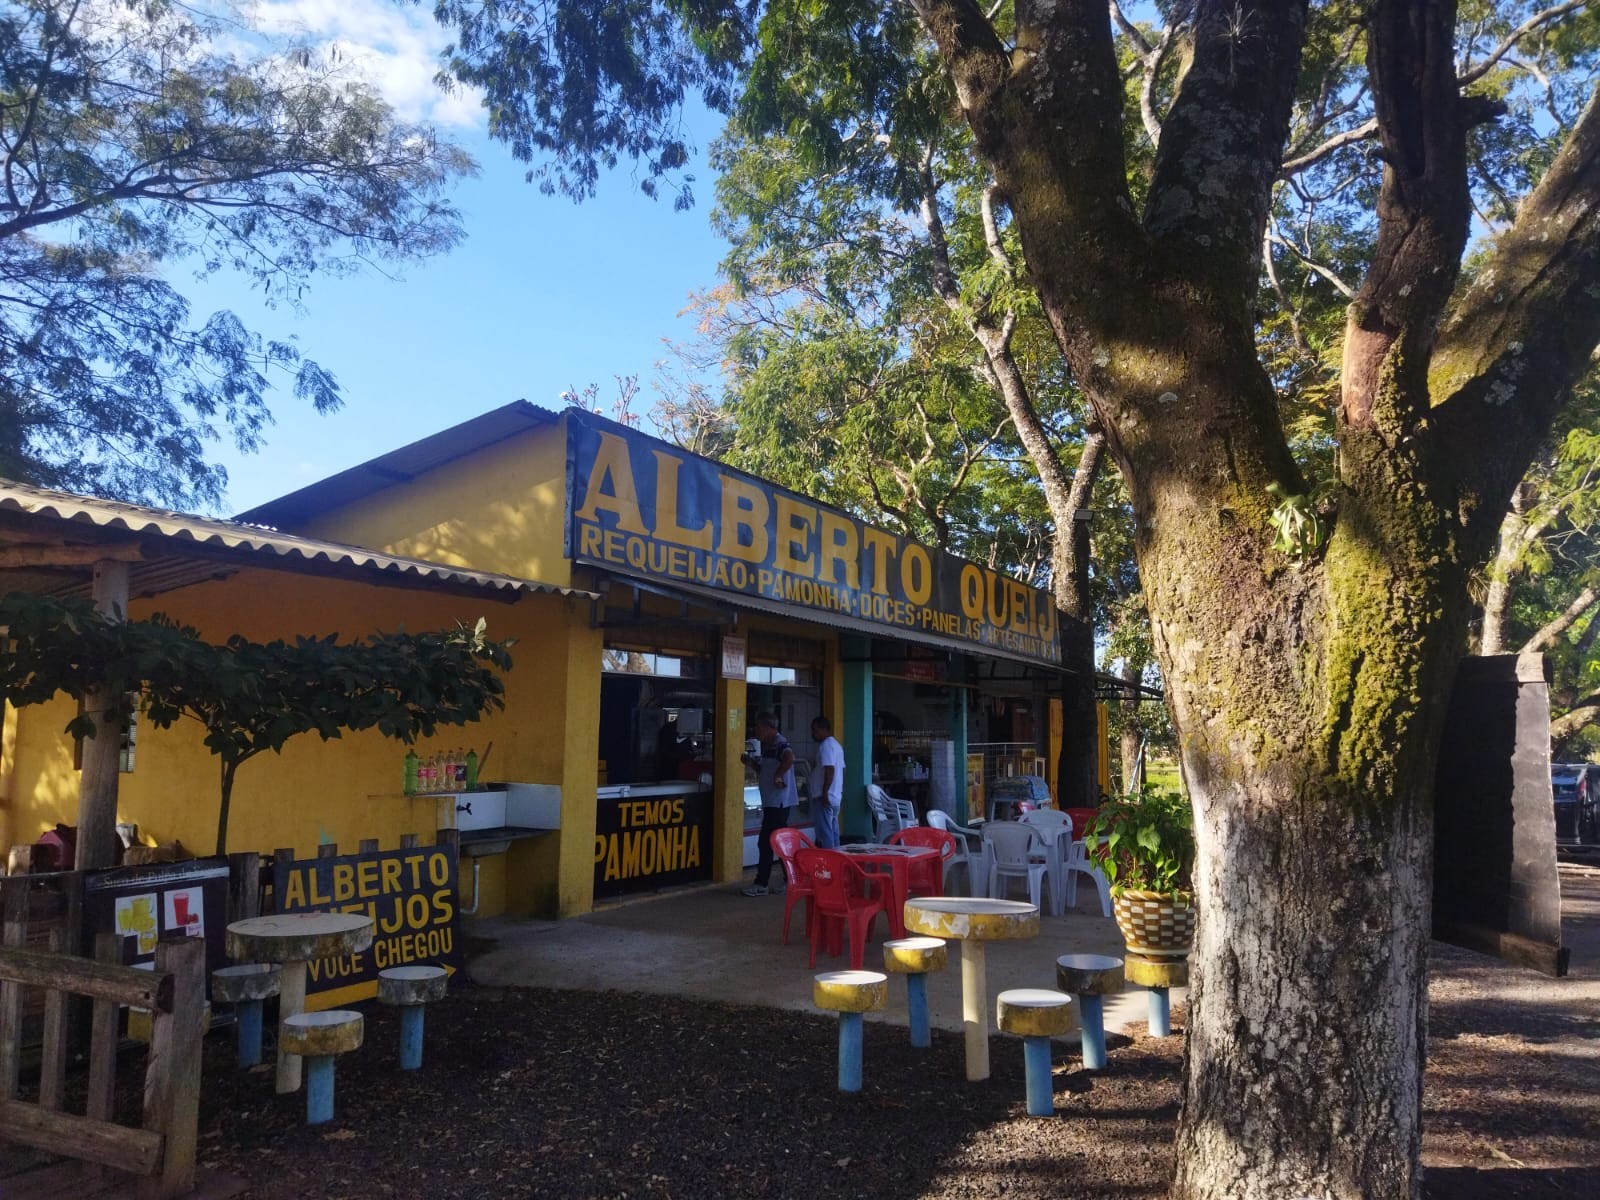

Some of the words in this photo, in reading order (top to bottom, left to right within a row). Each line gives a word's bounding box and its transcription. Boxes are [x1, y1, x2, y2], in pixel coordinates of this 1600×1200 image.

[575, 430, 932, 607] ALBERTO
[580, 523, 747, 590] REQUEIJÃO
[758, 569, 850, 612] PAMONHA
[860, 593, 915, 626] DOCES
[923, 607, 981, 641] PANELAS
[618, 799, 685, 828] TEMOS
[285, 852, 449, 909] ALBERTO
[595, 825, 700, 881] PAMONHA
[316, 889, 453, 937] IJOS
[374, 927, 453, 969] CHEGOU
